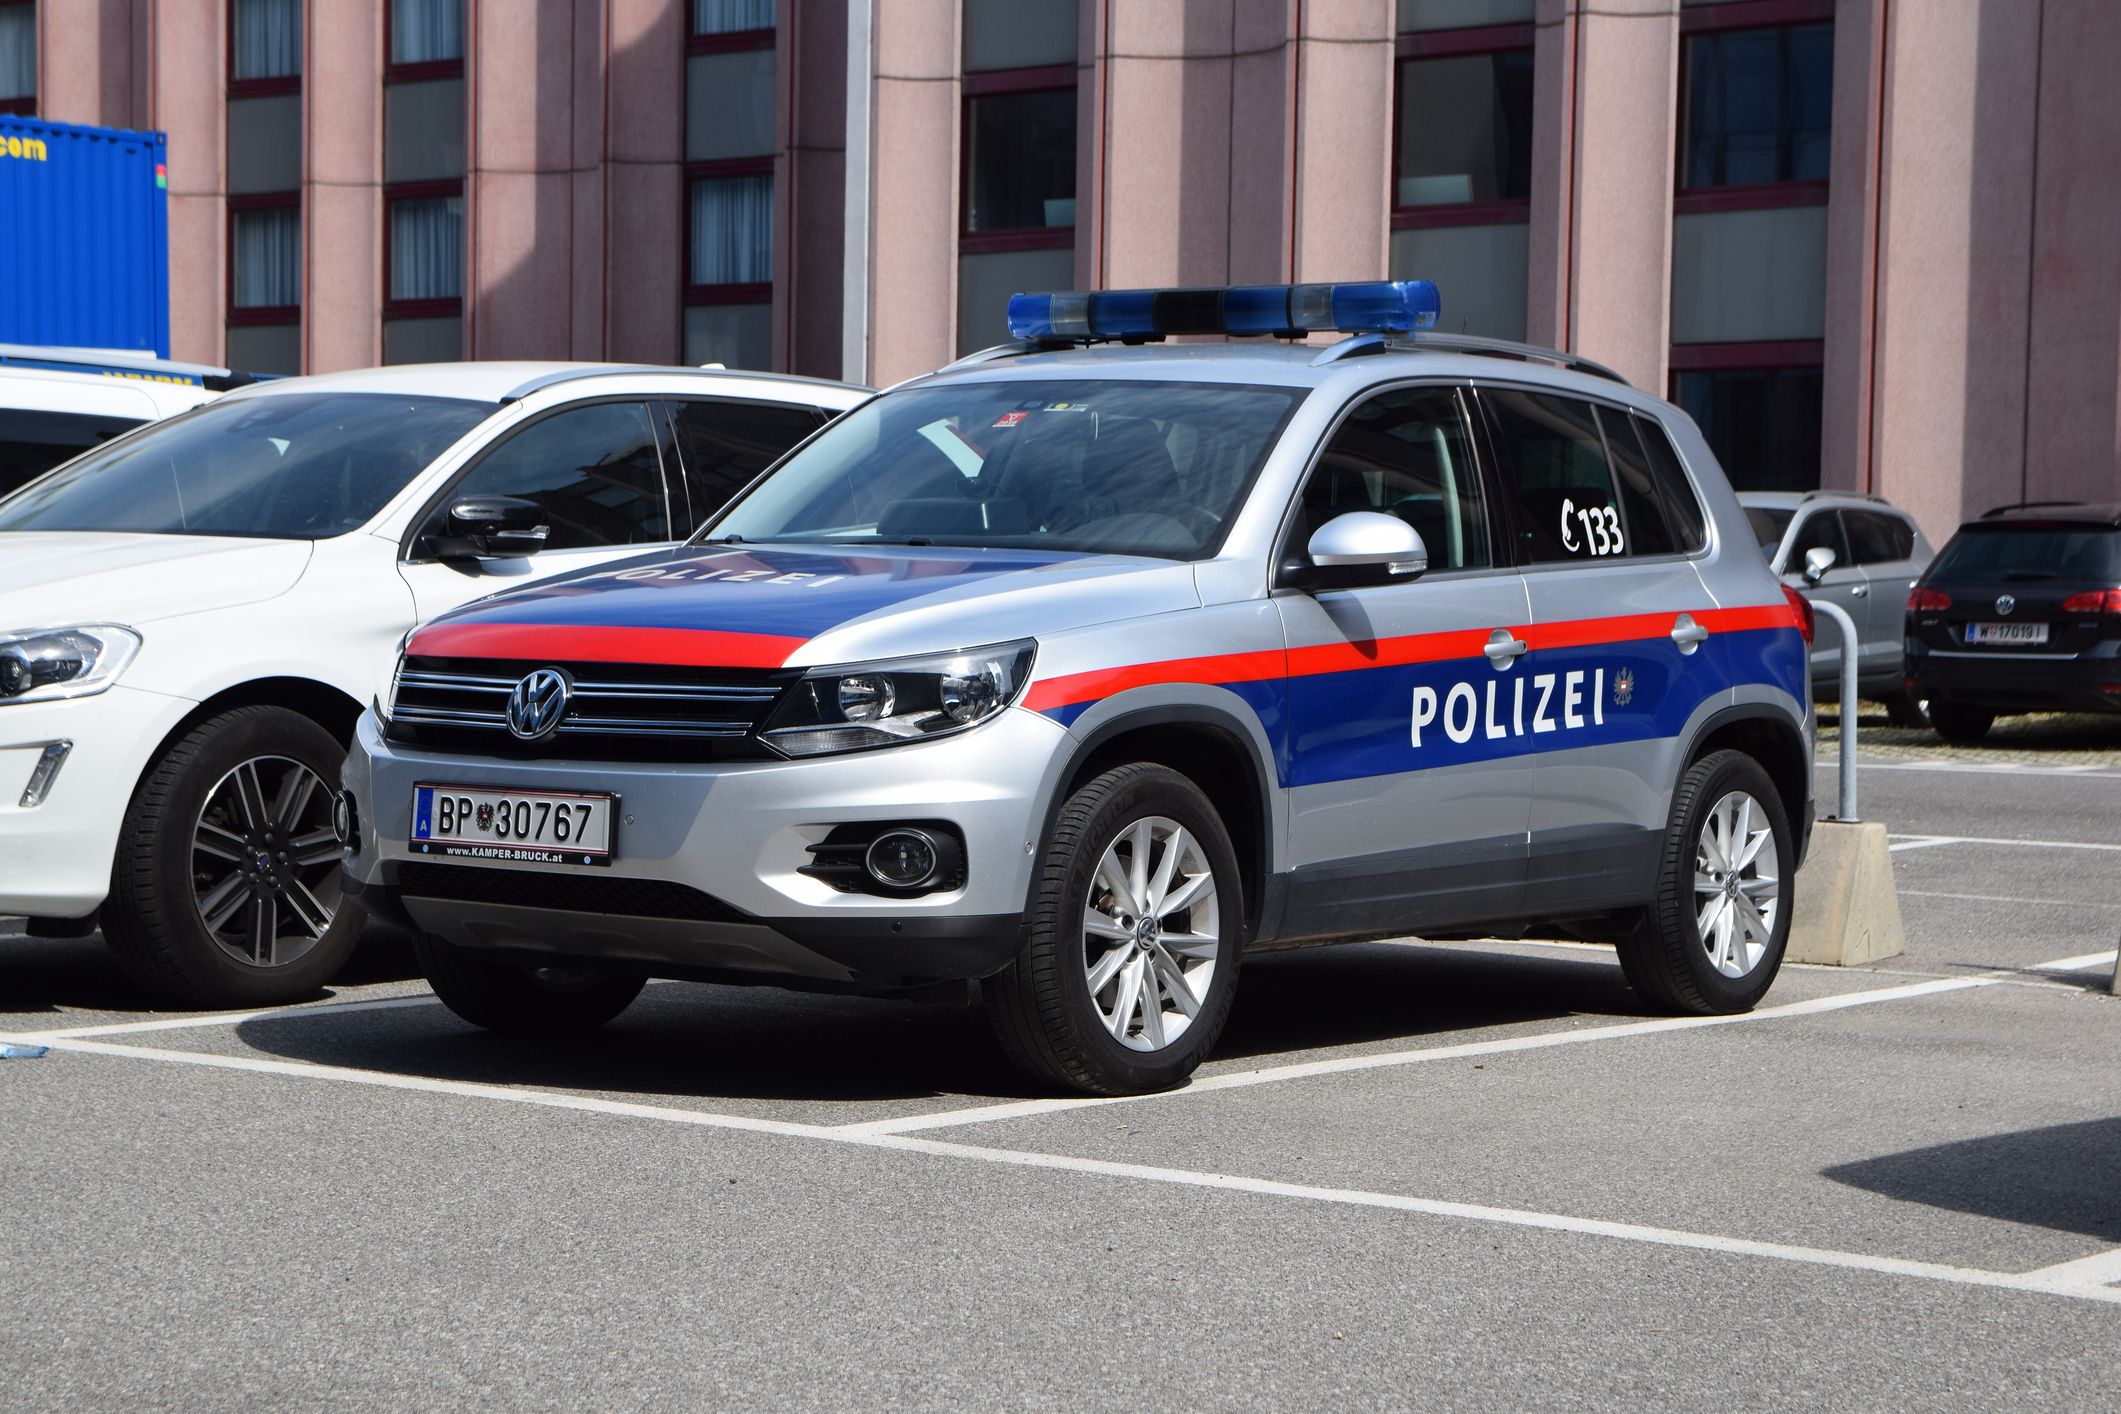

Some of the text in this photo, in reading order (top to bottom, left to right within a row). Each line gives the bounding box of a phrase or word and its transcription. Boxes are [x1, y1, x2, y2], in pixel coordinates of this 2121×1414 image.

[1578, 506, 1624, 556] 133
[507, 670, 566, 739] VW
[1411, 668, 1604, 748] POLIZEI
[420, 819, 428, 832] A
[439, 796, 593, 843] BP 30767
[446, 846, 563, 863] www.KAMPER-BRUCK.at
